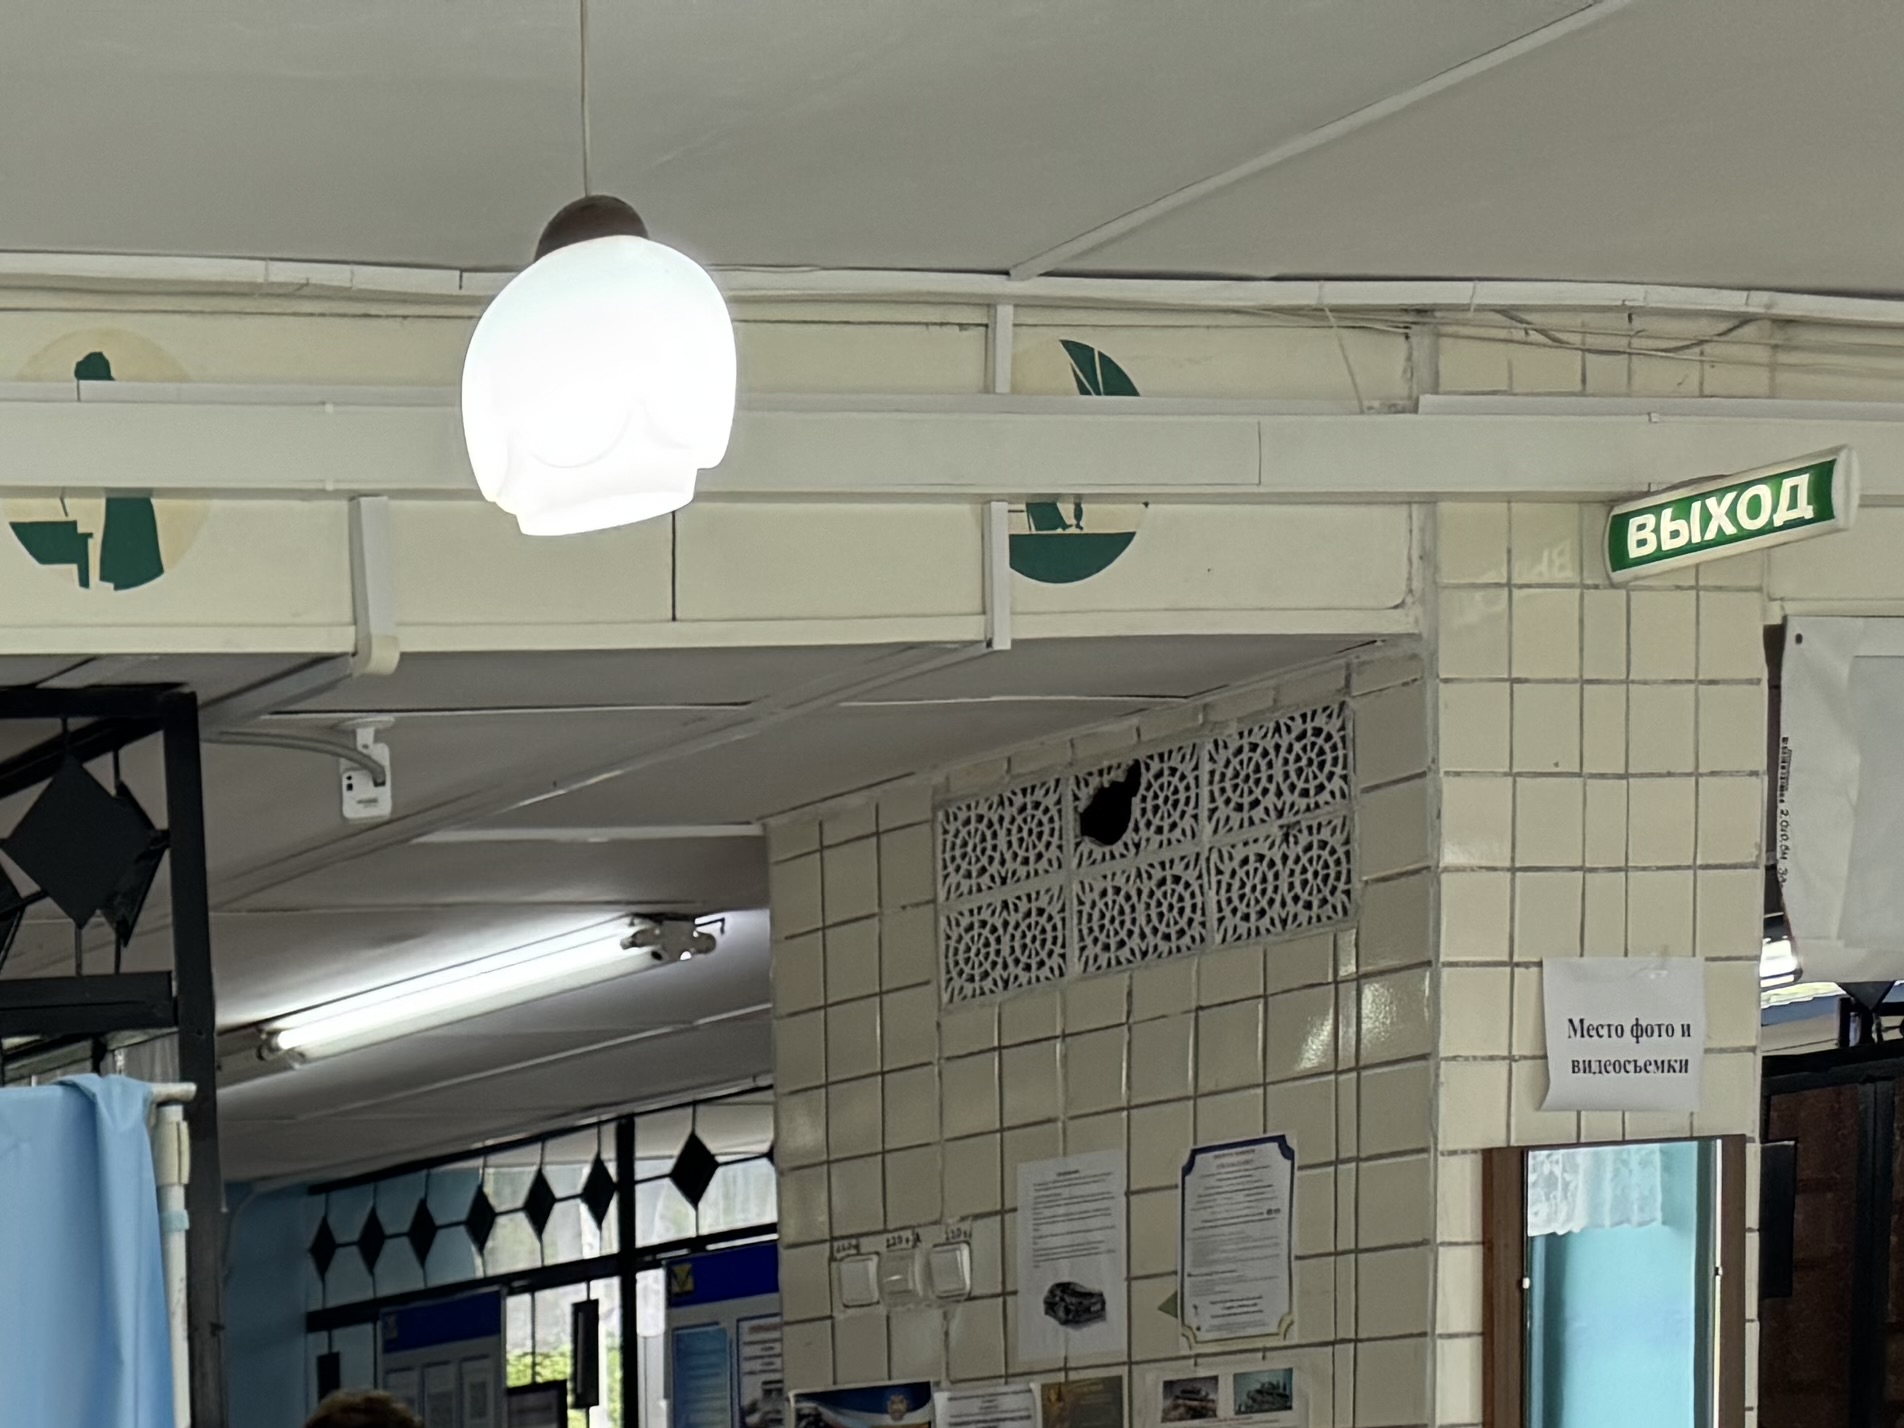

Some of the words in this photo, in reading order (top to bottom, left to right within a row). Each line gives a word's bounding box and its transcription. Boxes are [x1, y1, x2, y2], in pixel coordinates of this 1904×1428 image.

[1627, 472, 1815, 558] ВЫХОД
[1567, 1018, 1625, 1039] Место
[1630, 1017, 1675, 1044] фото
[1680, 1023, 1692, 1038] и
[1571, 1059, 1689, 1076] видеосъемки
